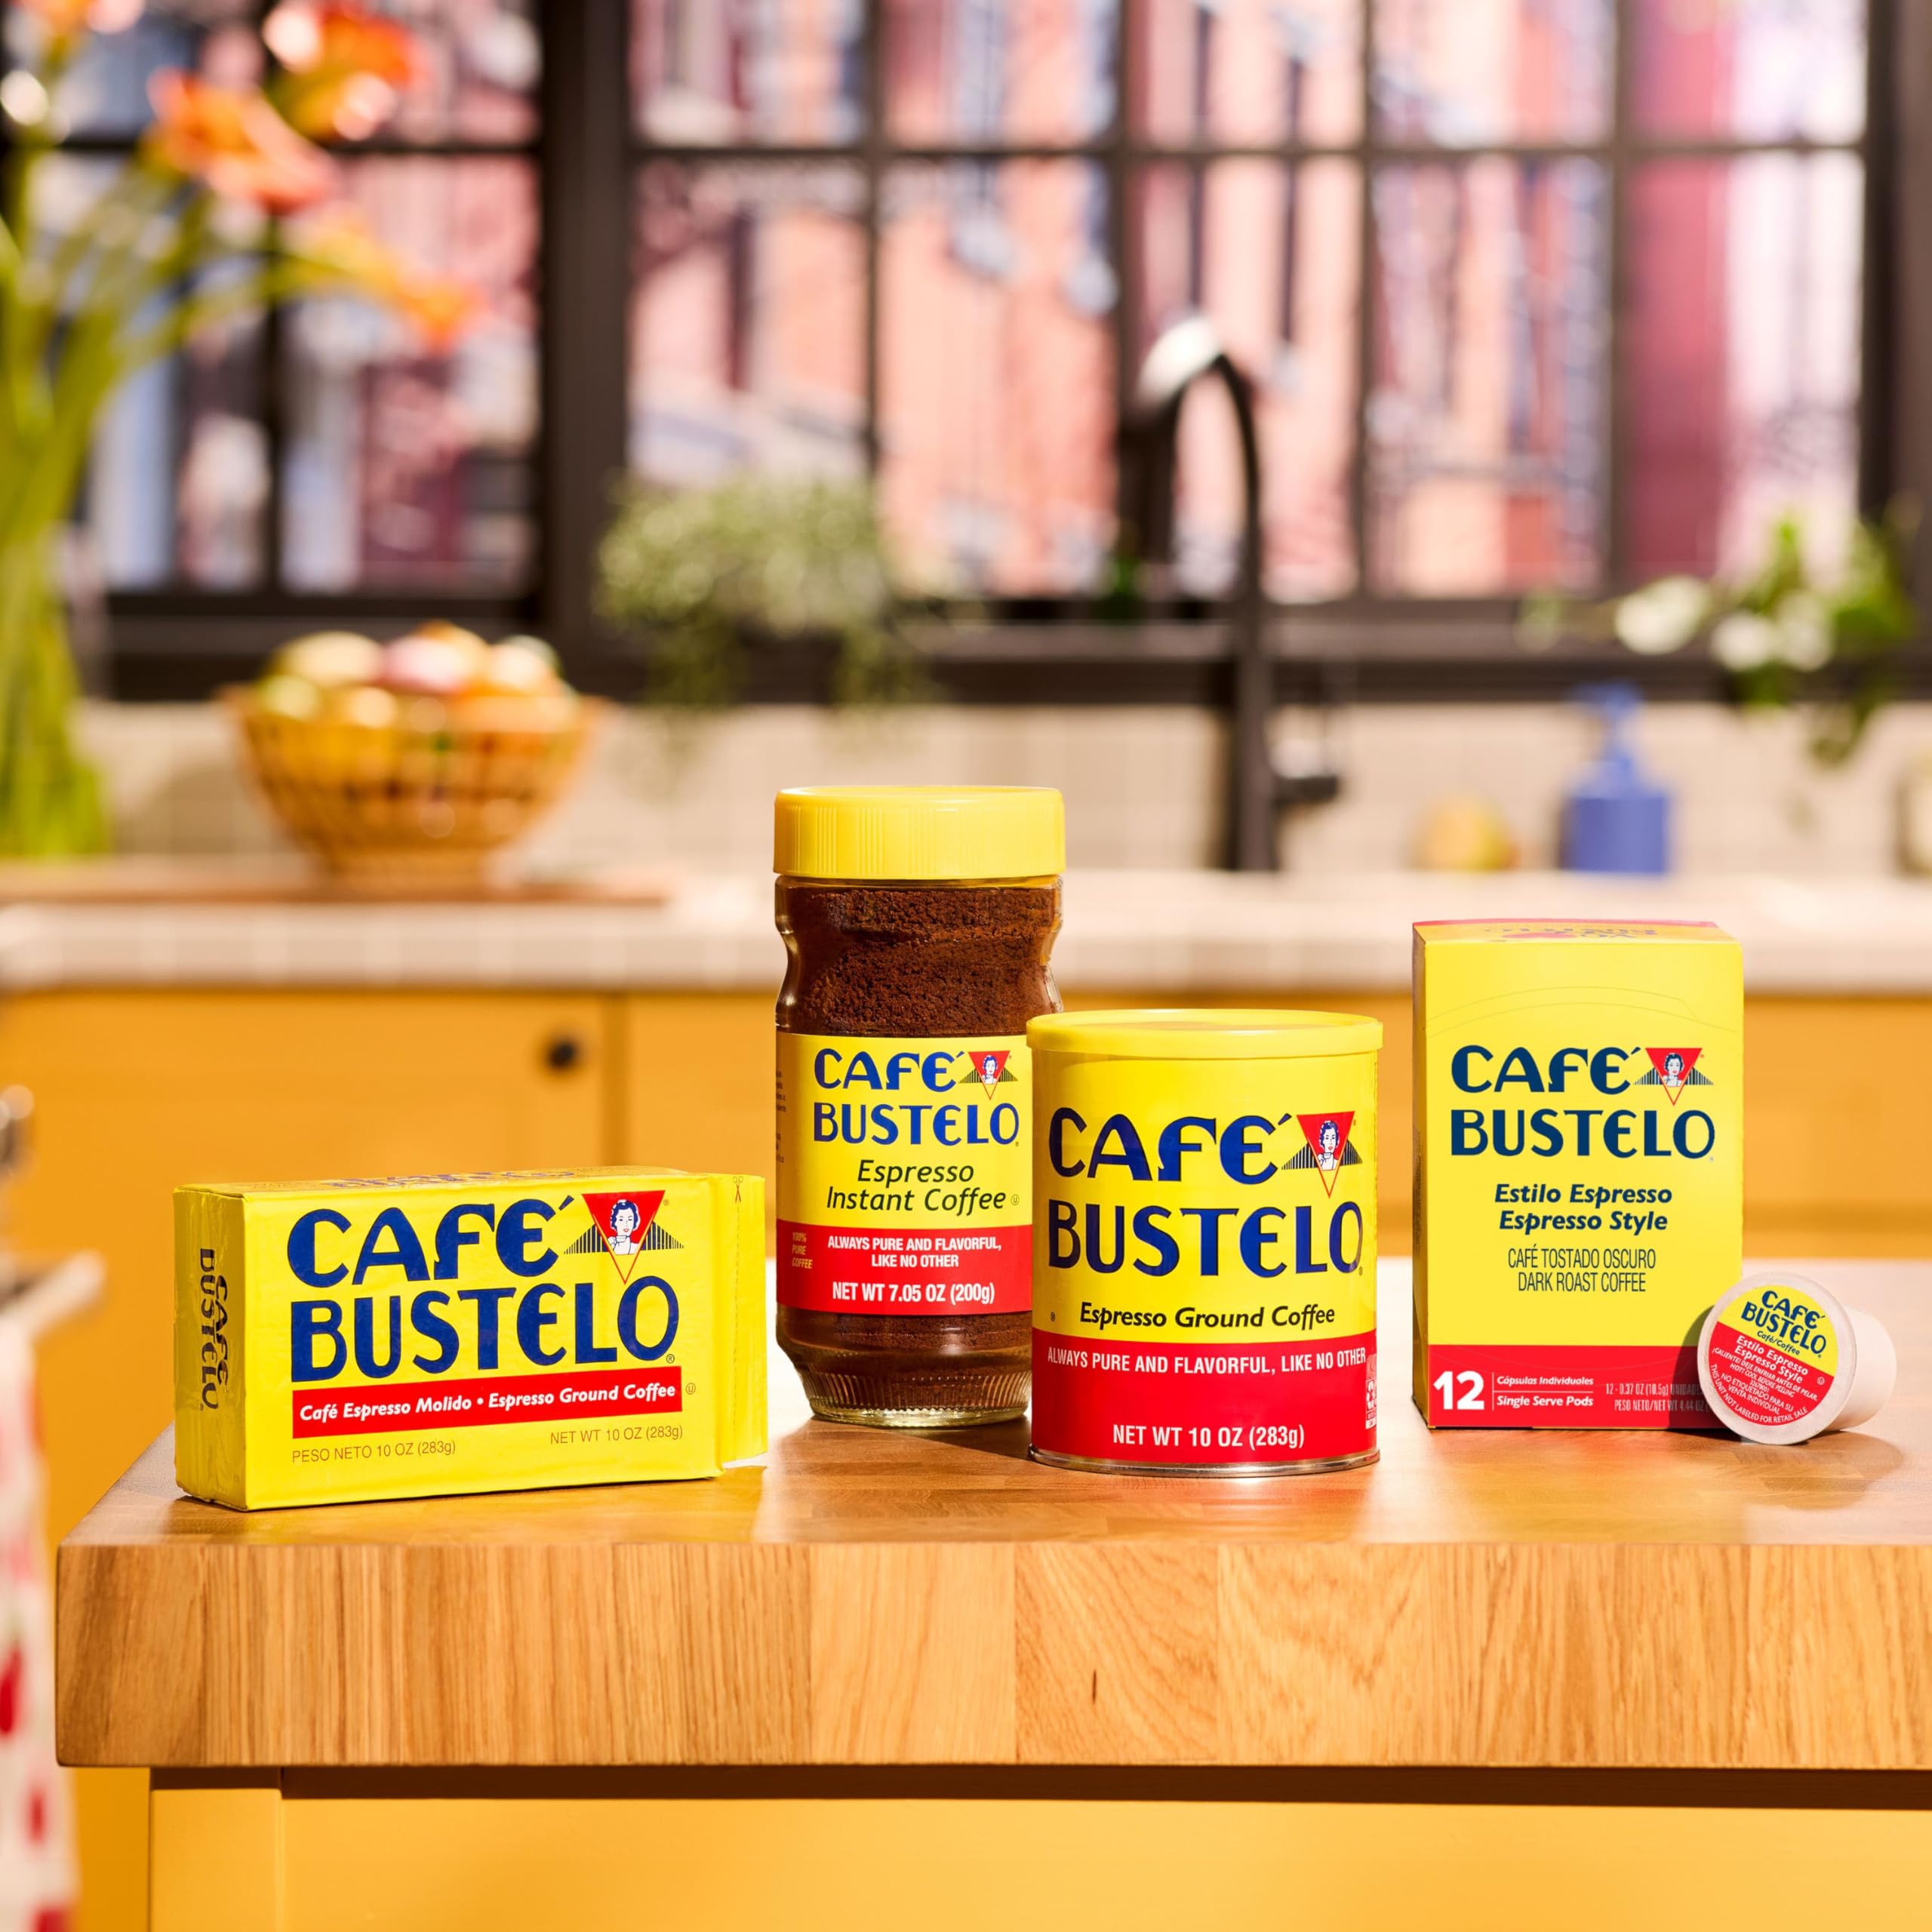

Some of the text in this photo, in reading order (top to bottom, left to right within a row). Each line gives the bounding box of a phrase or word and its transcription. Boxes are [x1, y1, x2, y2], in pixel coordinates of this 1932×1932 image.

[814, 1048, 964, 1092] CAFÉ
[1451, 1044, 1641, 1095] CAFÉ
[814, 1102, 1019, 1146] BUSTELO
[1451, 1109, 1715, 1159] BUSTELO
[1049, 1107, 1292, 1185] CAFÉ
[857, 1159, 974, 1189] Espresso
[826, 1186, 1006, 1217] Instant Coffee
[1494, 1183, 1672, 1209] Estilo Espresso
[1499, 1210, 1668, 1235] Espresso Style
[287, 1195, 574, 1288] CAFÉ
[792, 1232, 807, 1243] 100%
[792, 1244, 806, 1255] PURE
[828, 1235, 1001, 1251] ALWAYS PURE AND FLAVORFUL,
[1048, 1198, 1363, 1278] BUSTELO
[792, 1257, 813, 1269] COFFEE
[871, 1254, 958, 1267] LIKE NO OTHER
[1508, 1244, 1656, 1269] CAFÉ TOSTADO OSCURO
[832, 1281, 995, 1306] NET WT 7.05 OZ (200g)
[1518, 1272, 1646, 1292] DARK ROAST COFFEE
[1080, 1301, 1335, 1331] Espresso Ground Coffee
[1761, 1290, 1826, 1330] CAFÉ
[291, 1275, 679, 1383] BUSTELO
[1740, 1301, 1826, 1354] BUSTELO
[1737, 1335, 1808, 1375] Estilo Espresso
[1757, 1331, 1800, 1355] Café/Coffee
[1047, 1346, 1366, 1375] ALWAYS PURE AND FLAVORFUL, LIKE NO OTHER
[1734, 1345, 1803, 1383] Espresso Style
[1740, 1360, 1754, 1371] DEJE
[1753, 1366, 1776, 1380] ENFRIAR
[1775, 1377, 1793, 1389] ANTES
[1433, 1371, 1485, 1410] 12
[1497, 1376, 1594, 1386] Cápsulas Individuales
[1606, 1383, 1614, 1395] 12
[1620, 1383, 1633, 1395] 0.37
[1636, 1383, 1644, 1395] OZ
[1710, 1363, 1808, 1423] THIS UNIT NOT LABELED FOR RETAIL SALE
[1721, 1373, 1794, 1412] NO ETIQUETADO PARA SU
[1745, 1370, 1758, 1380] COOL
[1758, 1376, 1776, 1389] BEFORE
[1775, 1385, 1795, 1398] PEELING
[300, 1383, 675, 1423] Café Espresso Molido Espresso Ground Coffee
[1497, 1395, 1594, 1408] Single Serve Pods
[1614, 1399, 1630, 1411] PESO
[1632, 1399, 1666, 1412] NETO/NET
[1668, 1400, 1678, 1411] WT
[1728, 1384, 1781, 1414] VENTA INDIVIDUAL
[550, 1425, 683, 1444] NET WT 10 OZ (283g)
[1112, 1424, 1305, 1451] NET WT 10 OZ (283g)
[292, 1440, 456, 1463] PESO NETO 10 OZ (283g)
